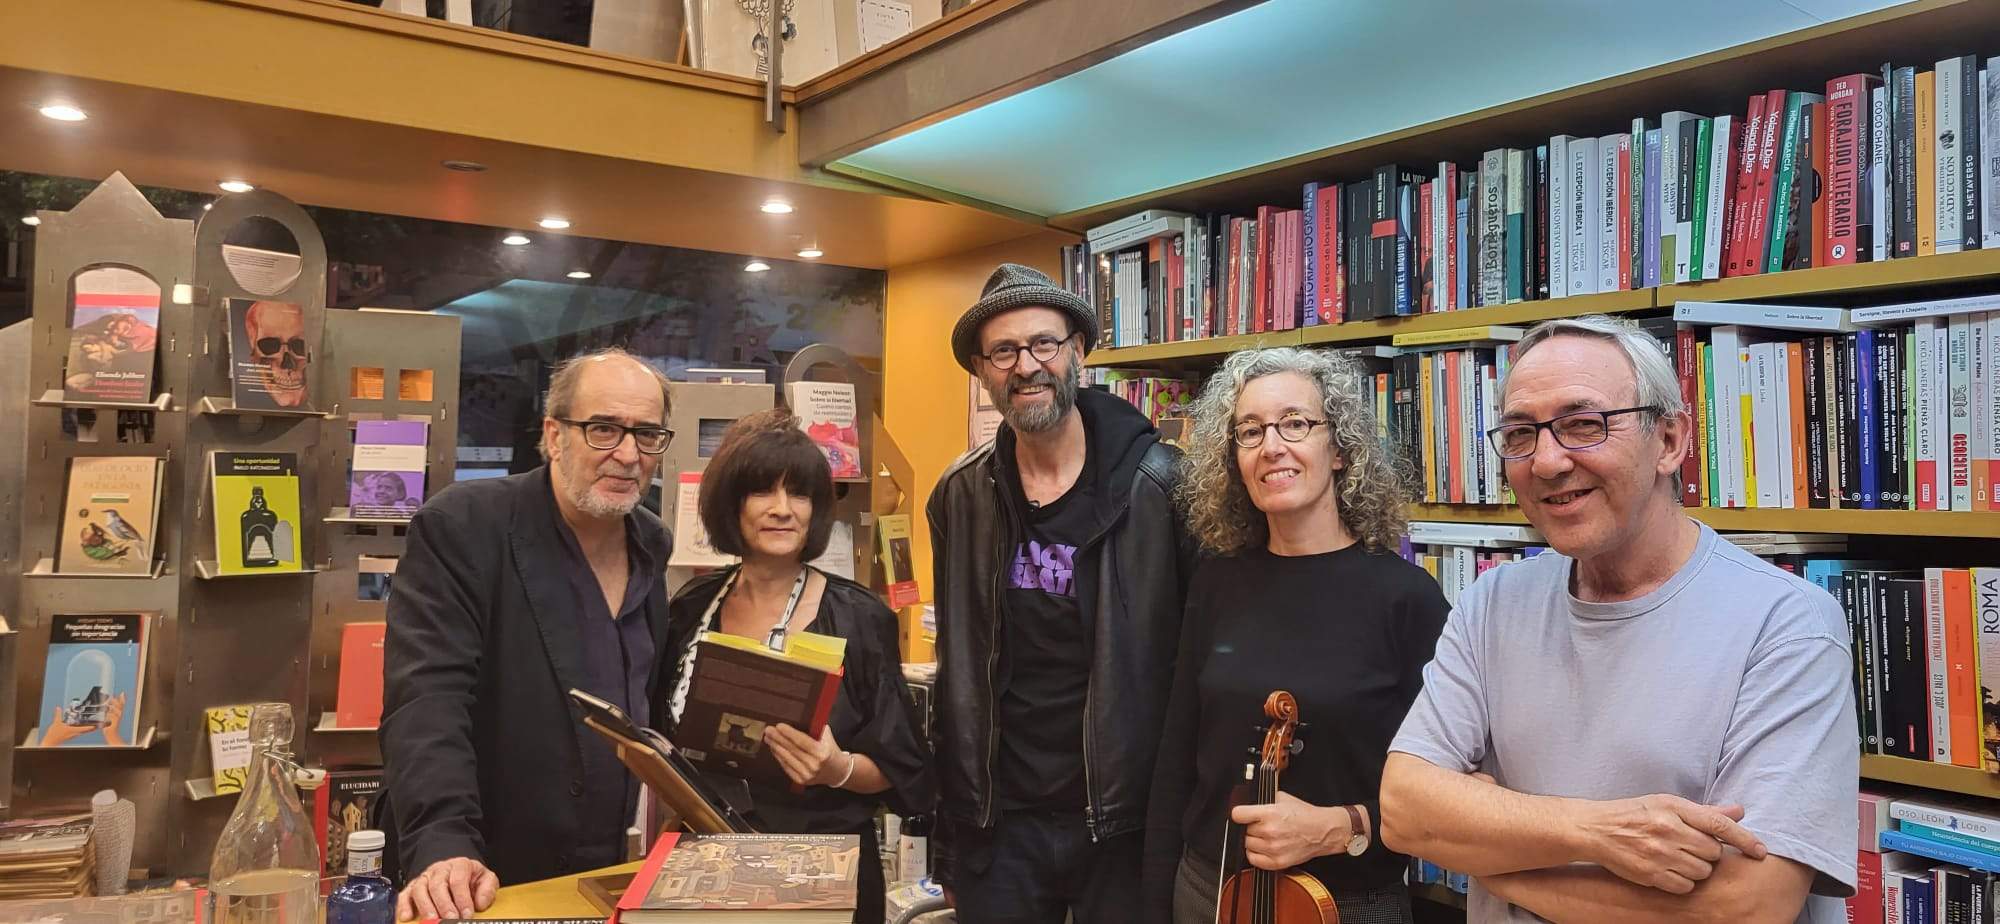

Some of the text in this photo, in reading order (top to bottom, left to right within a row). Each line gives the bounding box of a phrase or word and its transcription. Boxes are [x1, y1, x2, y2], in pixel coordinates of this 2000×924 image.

[1836, 81, 1847, 91] TED
[1745, 116, 1761, 174] Yolanda Díaz
[1762, 111, 1779, 170] Yolanda Díaz
[1783, 110, 1797, 172] MÓNICA GARCÍA
[1875, 100, 1883, 168] COCO CHANEL
[1576, 152, 1583, 161] LA
[1606, 147, 1613, 157] LA
[1858, 144, 1866, 183] GOODALL
[1576, 162, 1584, 202] EXCEPCIÓN
[1606, 158, 1614, 198] EXCEPCIÓN
[1834, 102, 1852, 238] FORAJIDO LITERARIO
[1944, 156, 1955, 213] ADICCIÓN
[1966, 155, 1974, 220] EL METAVERSO
[1324, 200, 1332, 231] pasos
[1576, 203, 1584, 232] IBÉRICA
[1606, 200, 1614, 228] IBÉRICA
[1739, 201, 1748, 222] Manuel
[1757, 198, 1765, 219] Manuel
[1322, 232, 1330, 247] los
[1484, 186, 1500, 270] Borregueros
[1553, 186, 1561, 284] SUMMA DAEMONIACA
[1323, 252, 1330, 262] de
[1336, 232, 1344, 255] Aragón
[1602, 240, 1610, 270] TISCAR
[1323, 285, 1330, 294] el
[1398, 273, 1406, 281] EL
[1976, 328, 1982, 336] De
[246, 457, 280, 465] oportunidad
[1953, 434, 1968, 487] DELICIOSO
[1014, 540, 1078, 570] LACK
[1930, 579, 1940, 605] MONSTRUO
[1982, 579, 1999, 634] ROMA
[94, 624, 126, 632] desgracias
[1931, 617, 1942, 635] HABLAR
[1932, 640, 1943, 661] ENSEÑAR
[1933, 674, 1945, 709] JOSÉ VALES
[1962, 822, 1987, 833] LOBO
[1940, 850, 1955, 858] BAJO
[1956, 854, 1985, 865] CONTROL
[1976, 885, 1982, 893] LA
